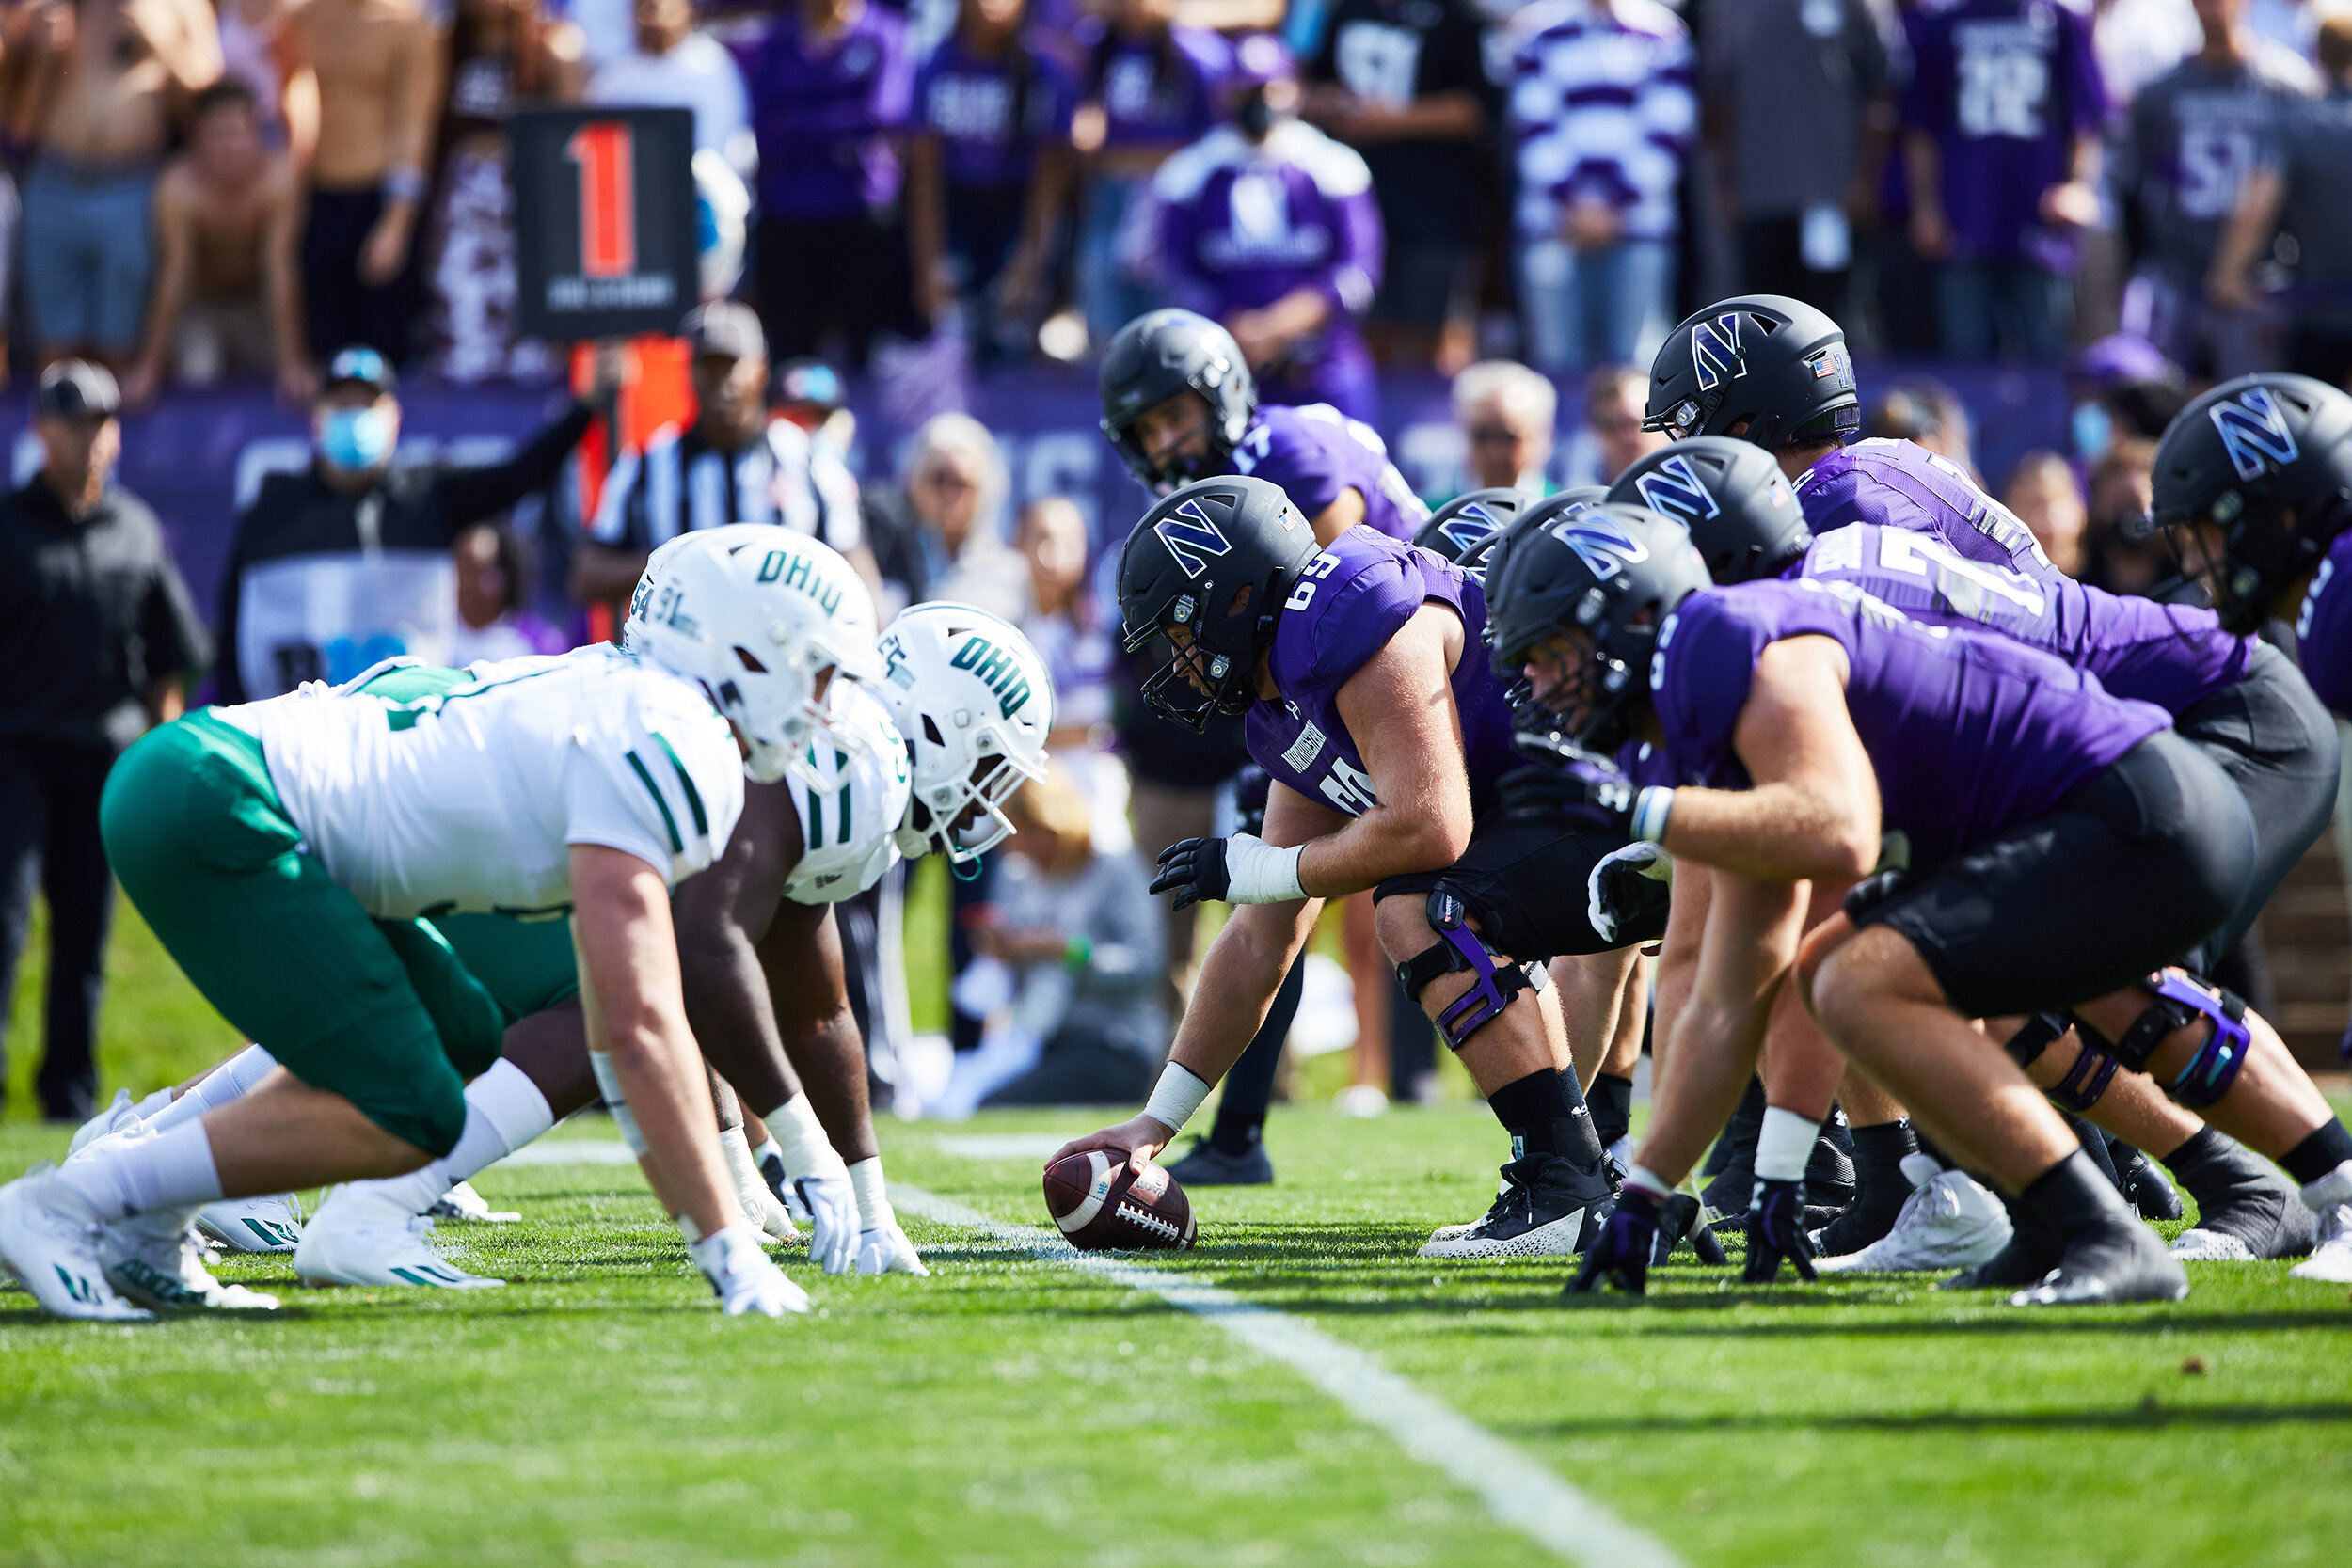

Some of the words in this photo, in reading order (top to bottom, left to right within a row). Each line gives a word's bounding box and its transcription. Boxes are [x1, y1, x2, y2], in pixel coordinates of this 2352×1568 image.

[564, 120, 636, 277] 1
[1692, 312, 1748, 391] N
[2208, 386, 2300, 483] N
[1438, 501, 1506, 553] N
[1635, 454, 1721, 530] N
[1153, 499, 1232, 580] N
[1551, 508, 1649, 581] N
[631, 582, 654, 623] 54
[758, 550, 843, 618] OHIO
[1285, 552, 1342, 612] 69
[950, 636, 1031, 721] OHIO
